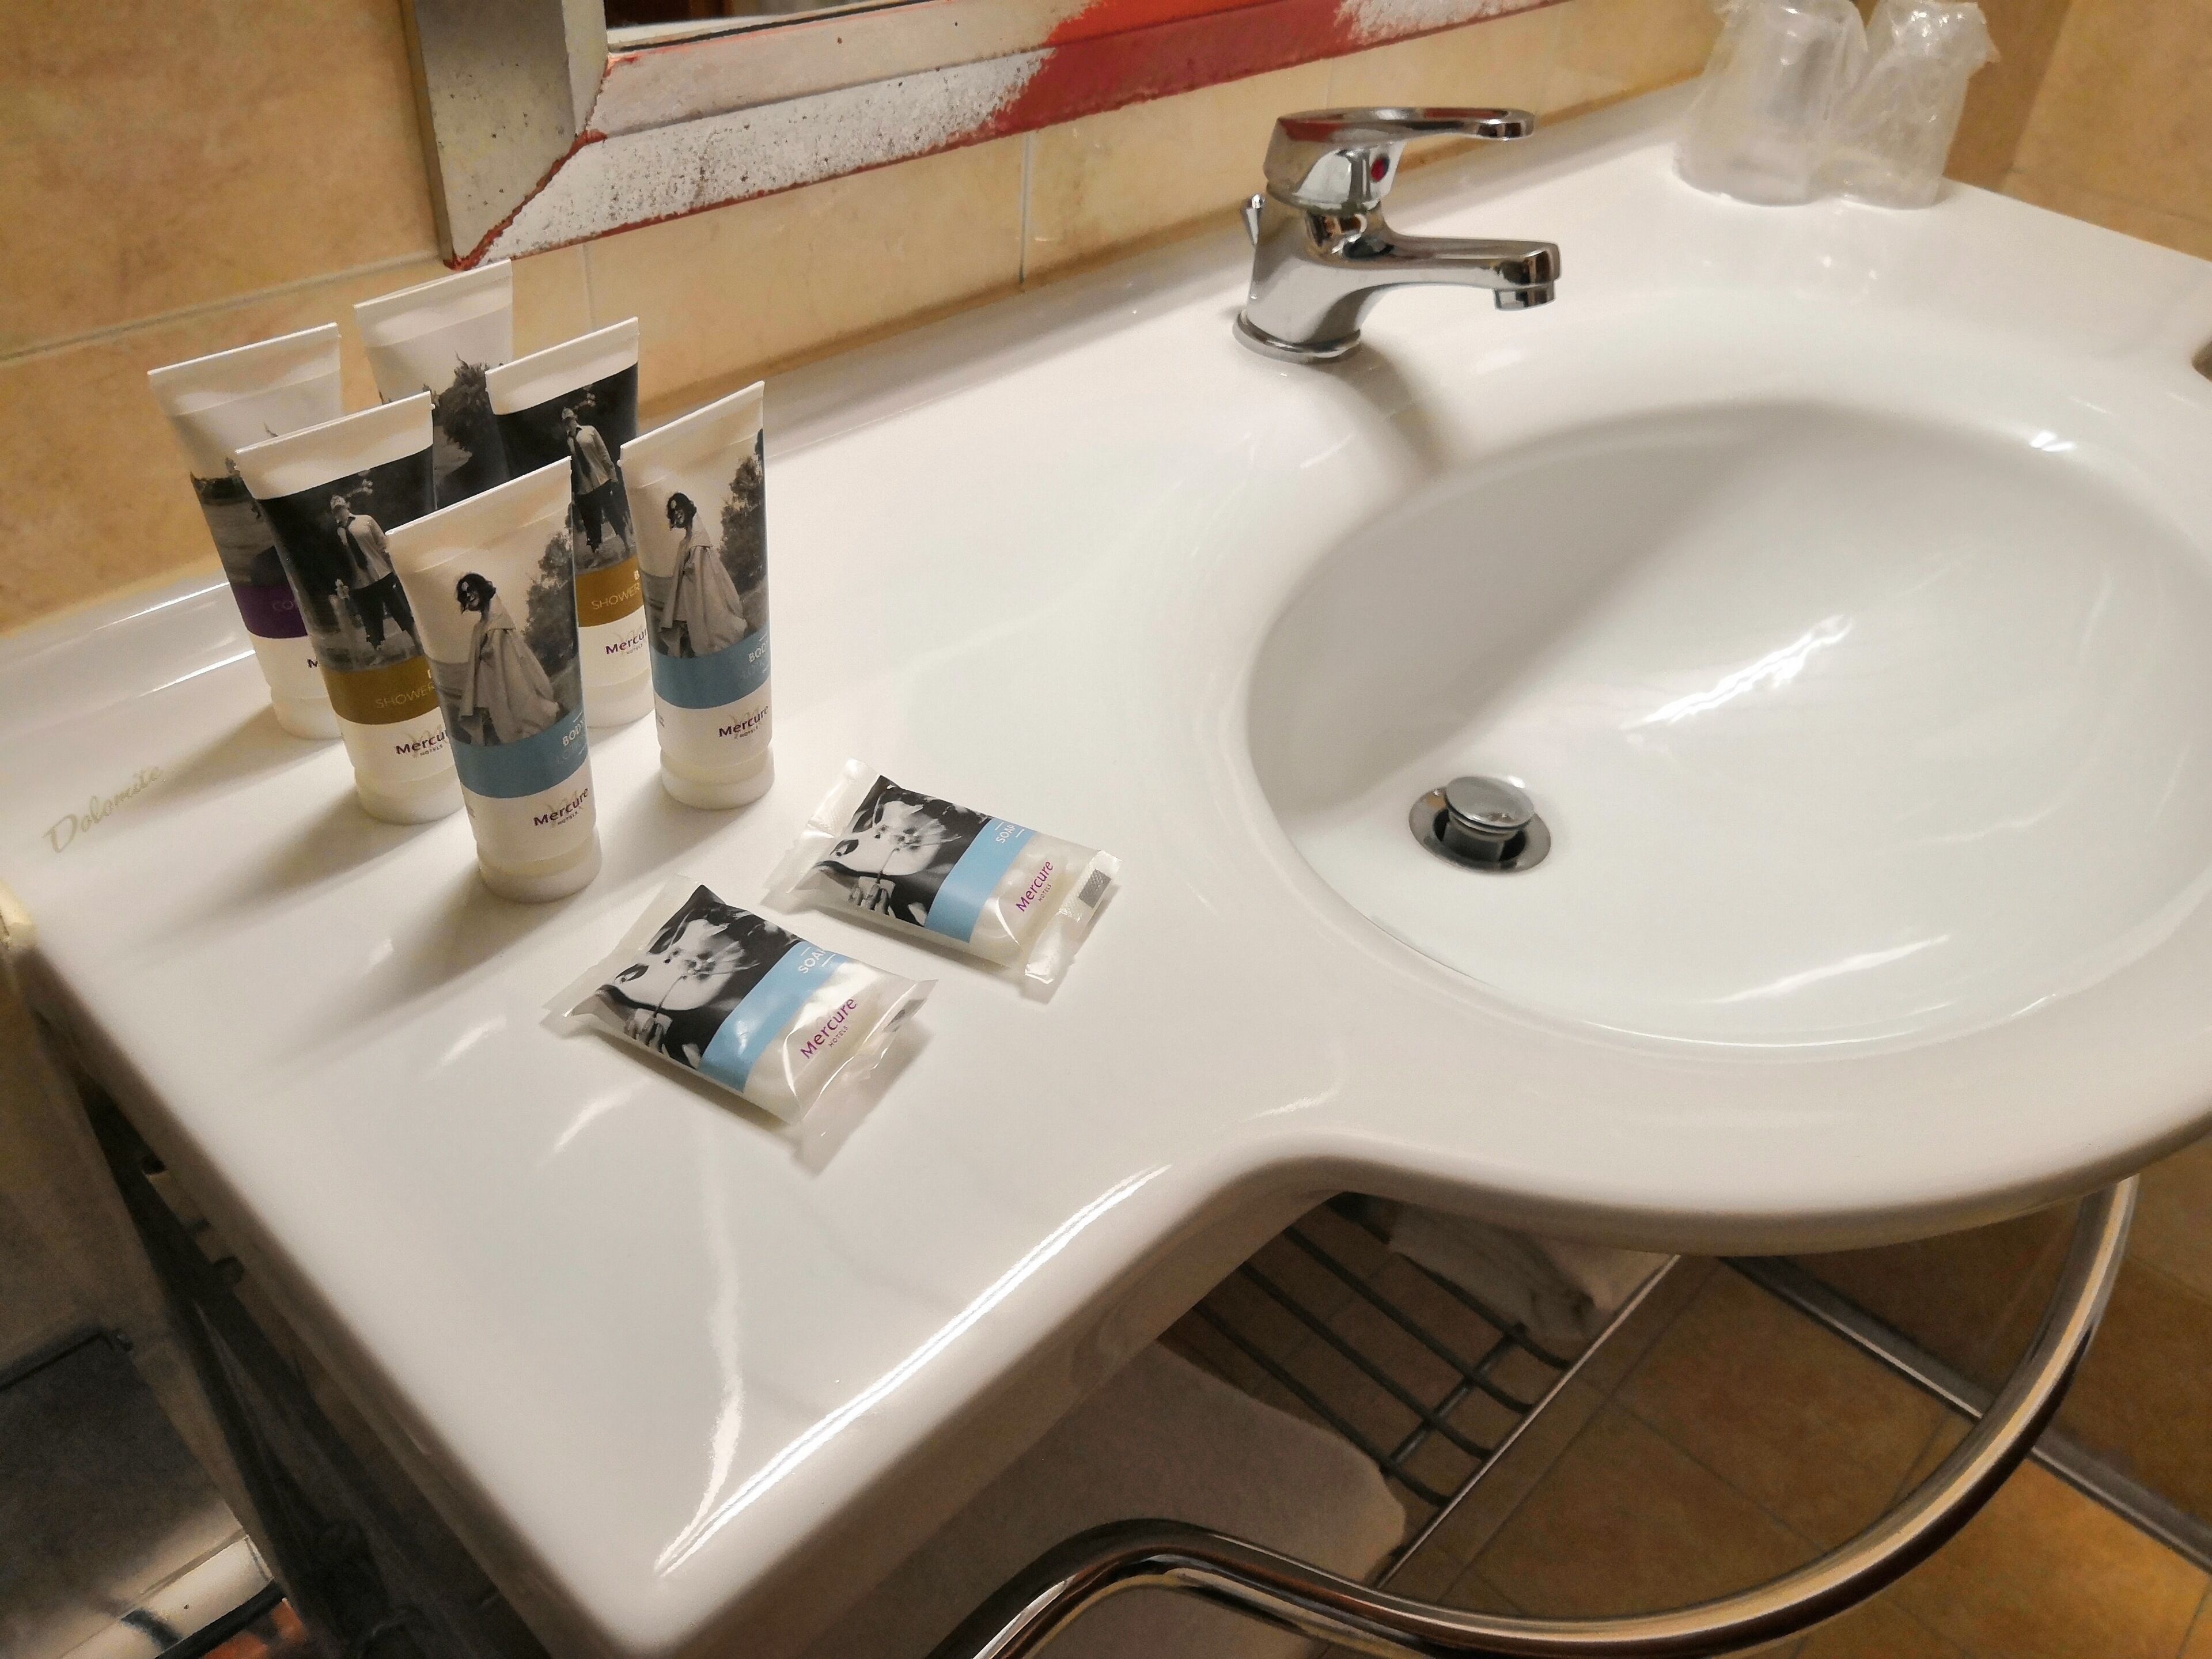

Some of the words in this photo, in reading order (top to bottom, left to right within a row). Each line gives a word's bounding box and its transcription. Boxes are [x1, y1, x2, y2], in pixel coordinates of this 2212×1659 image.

[591, 582, 641, 610] SHOWER
[605, 628, 647, 655] Mercur
[748, 641, 768, 663] BOD
[375, 681, 435, 709] SHOWER
[562, 719, 584, 747] BOD
[718, 705, 768, 737] Mercure
[395, 731, 445, 755] Mercu
[41, 766, 162, 853] Dolomite
[533, 787, 588, 827] Mercure
[995, 824, 1016, 843] SOAP
[1015, 861, 1054, 912] Mercure
[1038, 883, 1052, 903] HOTELS
[800, 998, 858, 1059] Mercure
[828, 1025, 849, 1048] HOTELS
